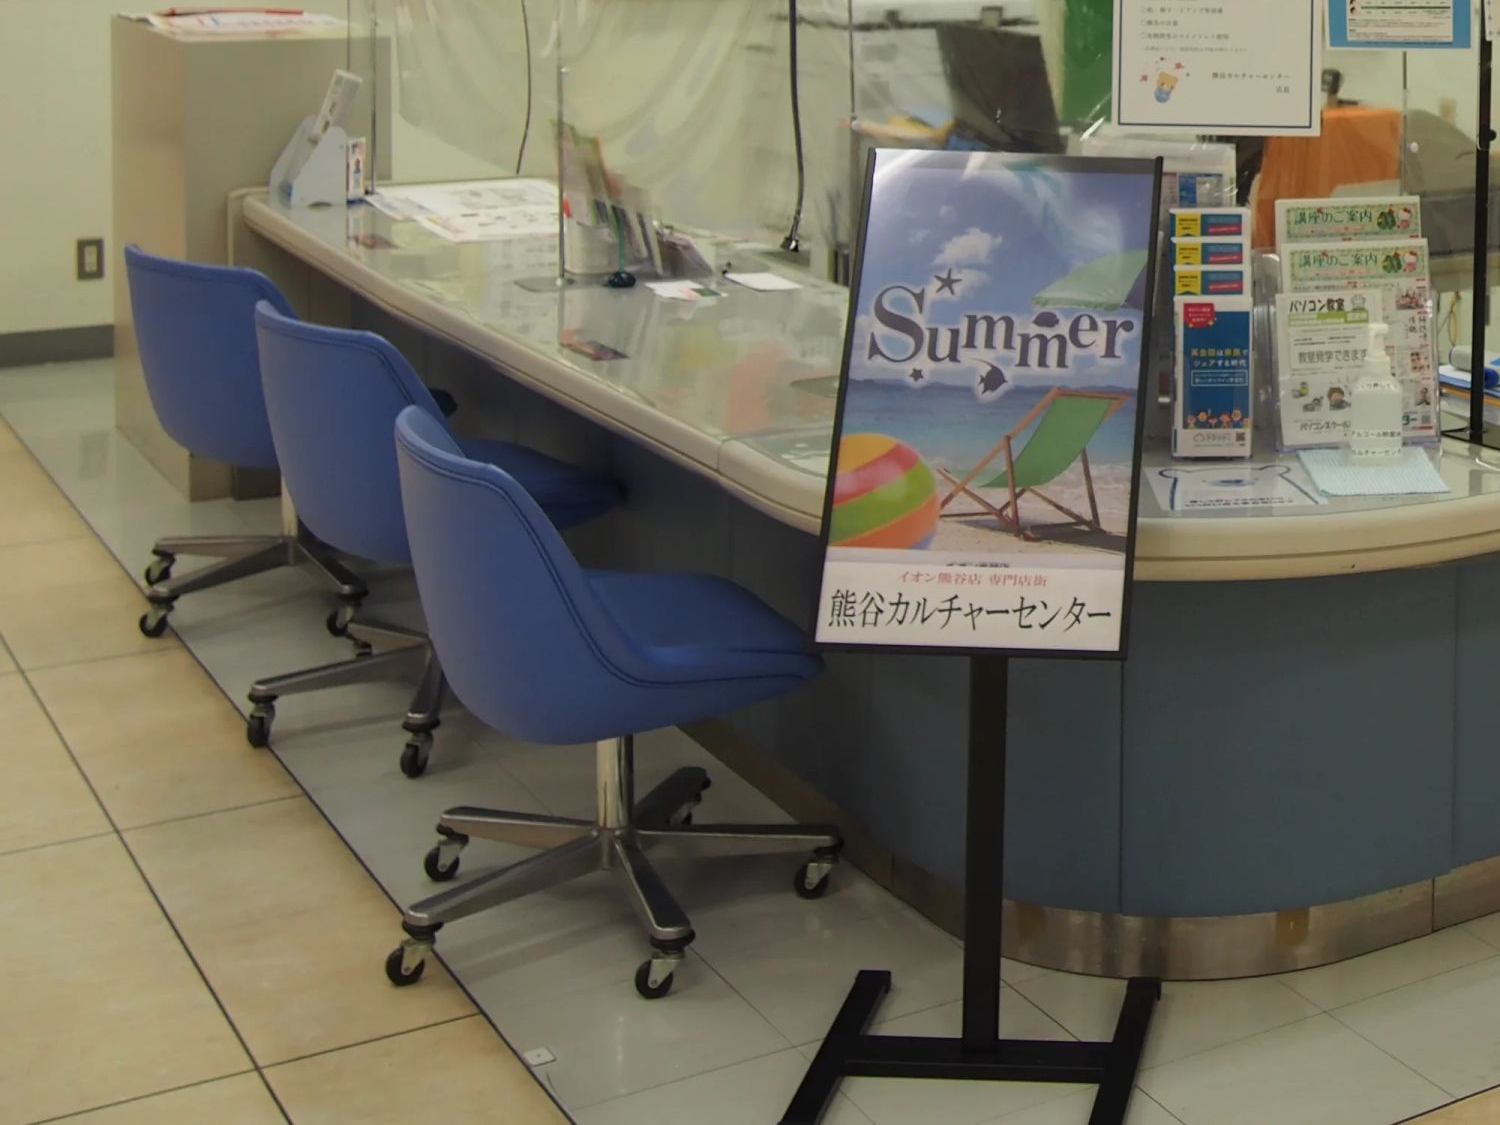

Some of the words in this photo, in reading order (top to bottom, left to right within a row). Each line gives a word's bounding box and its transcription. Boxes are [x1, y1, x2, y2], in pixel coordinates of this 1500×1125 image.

[867, 283, 1134, 369] Summer
[899, 571, 982, 585] イオン熊谷店
[989, 572, 1047, 588] 専門店街
[828, 588, 1112, 632] 熊谷カルチャーセンター
